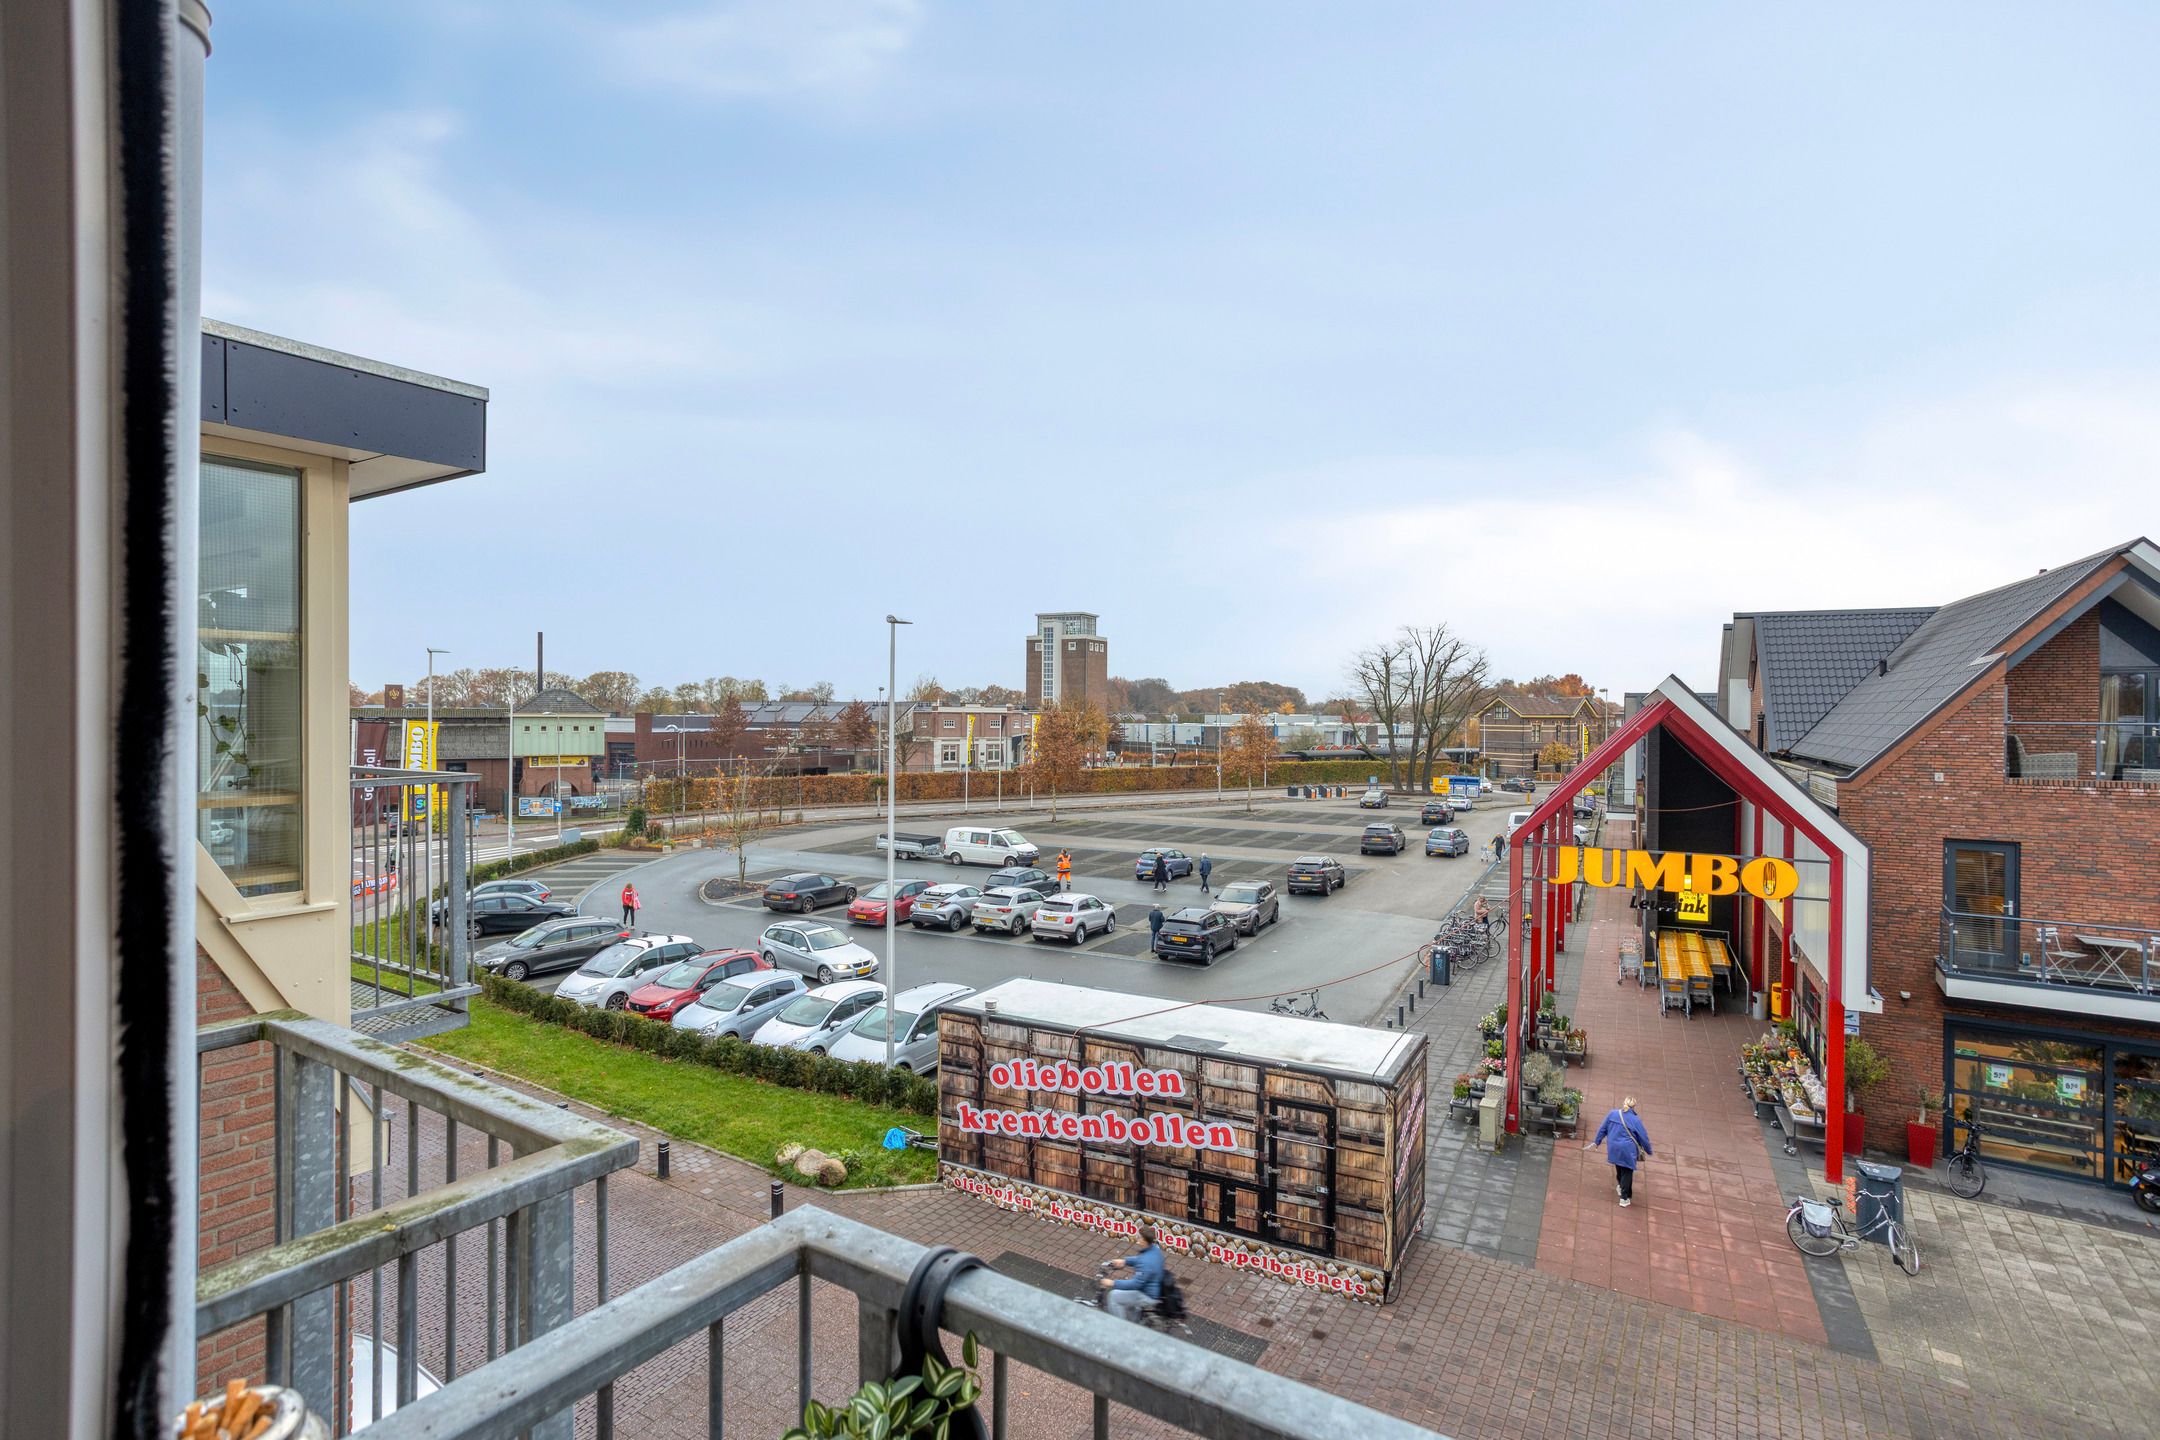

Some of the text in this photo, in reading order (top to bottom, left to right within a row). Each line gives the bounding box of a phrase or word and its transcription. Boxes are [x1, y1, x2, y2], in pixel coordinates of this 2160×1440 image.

[1548, 845, 1799, 900] JUMBO
[1629, 893, 1707, 914] Leuink
[991, 1060, 1183, 1095] oliebollen
[958, 1103, 1235, 1149] krentenbollen
[1050, 1201, 1188, 1250] krentenbllen
[1210, 1245, 1367, 1296] appelbeignets
